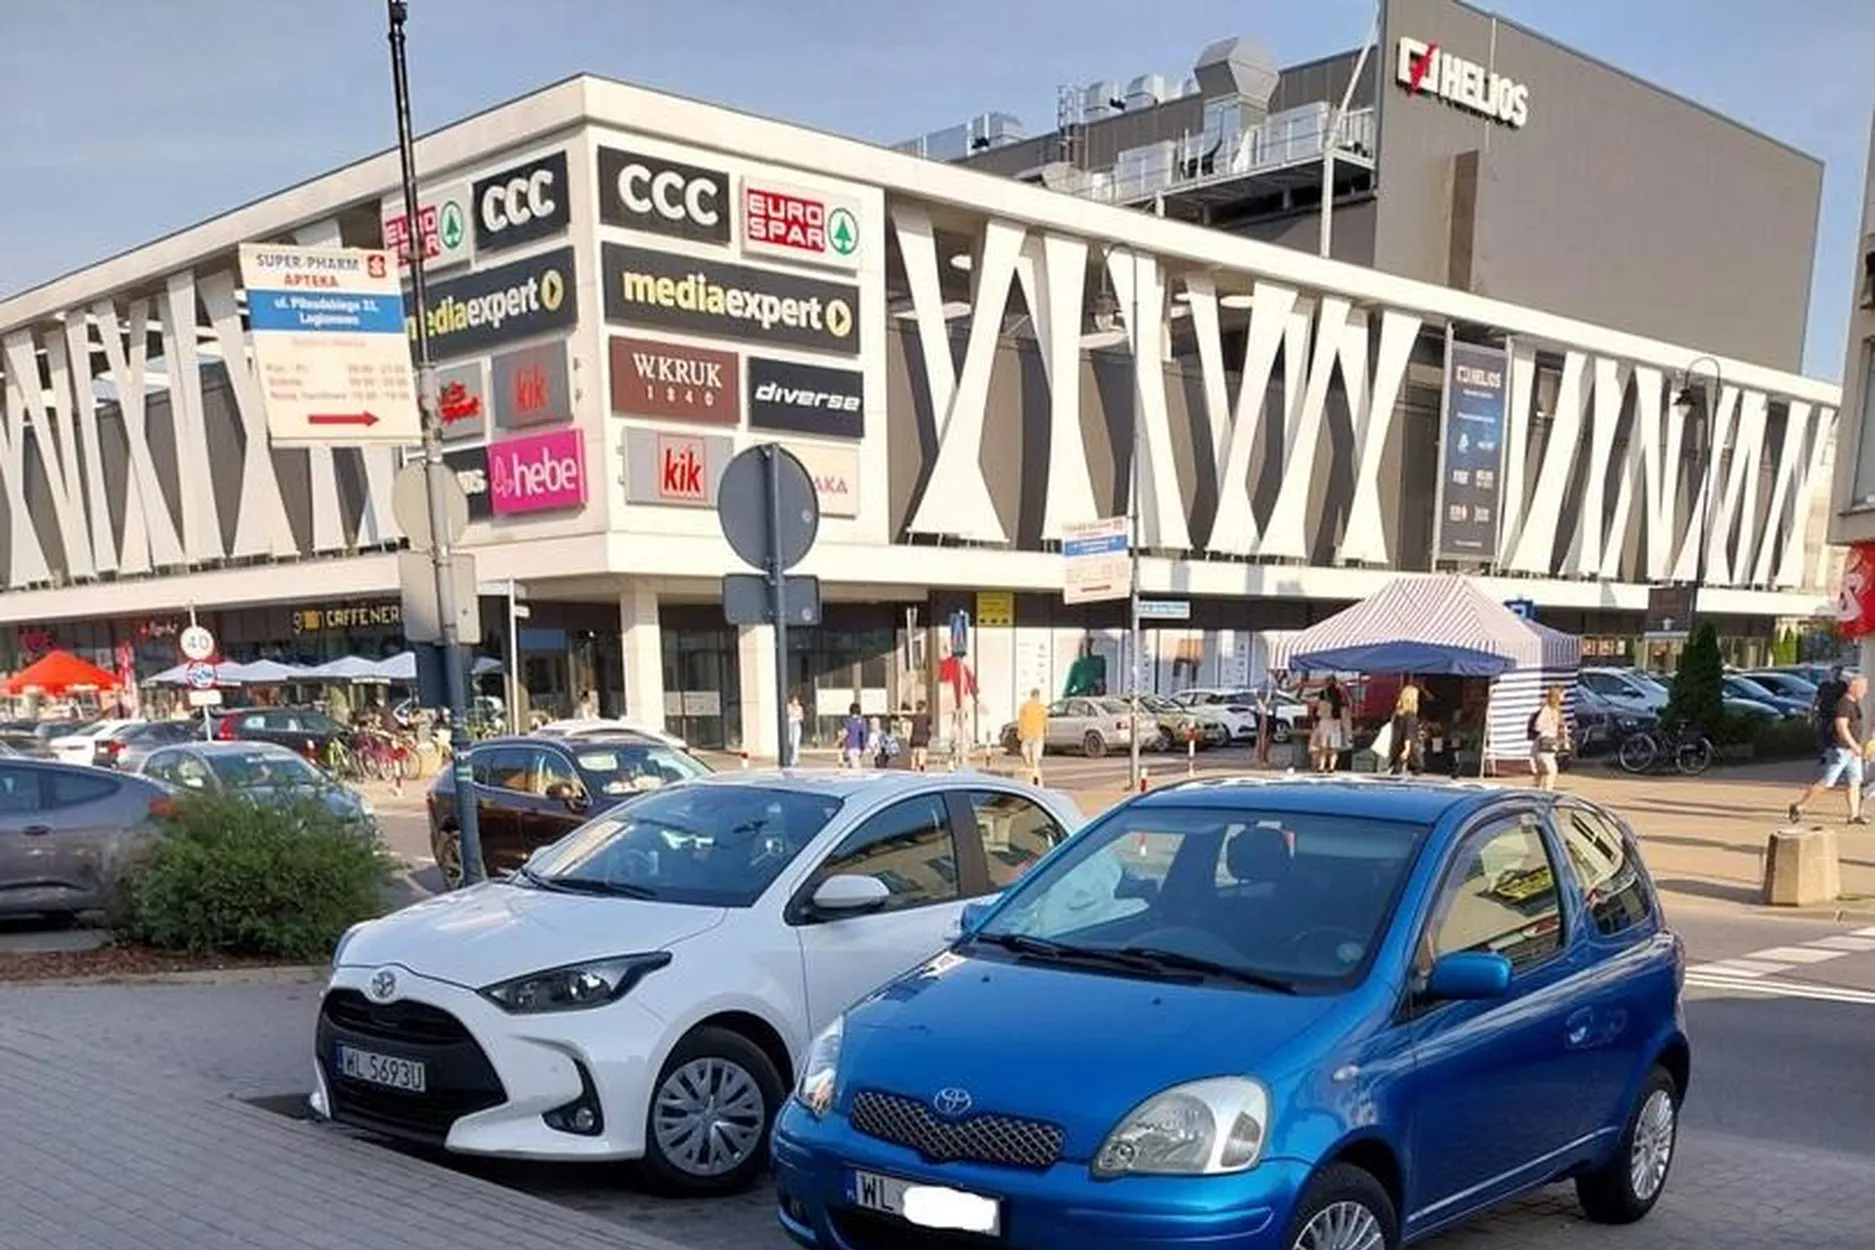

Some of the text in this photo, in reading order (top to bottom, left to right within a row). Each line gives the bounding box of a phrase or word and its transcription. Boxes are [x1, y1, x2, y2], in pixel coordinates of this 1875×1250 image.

[1439, 53, 1529, 127] HELIOS
[482, 169, 556, 232] CCC
[618, 164, 719, 226] CCC
[749, 194, 824, 224] EURO
[387, 210, 437, 246] EUO
[749, 217, 825, 249] SPAR
[283, 274, 340, 288] APTEKA
[622, 270, 823, 330] mediaexpert
[755, 380, 862, 412] diverse
[511, 447, 577, 497] hebe
[663, 448, 702, 493] kik
[369, 605, 400, 625] NER
[861, 1174, 895, 1212] WL
